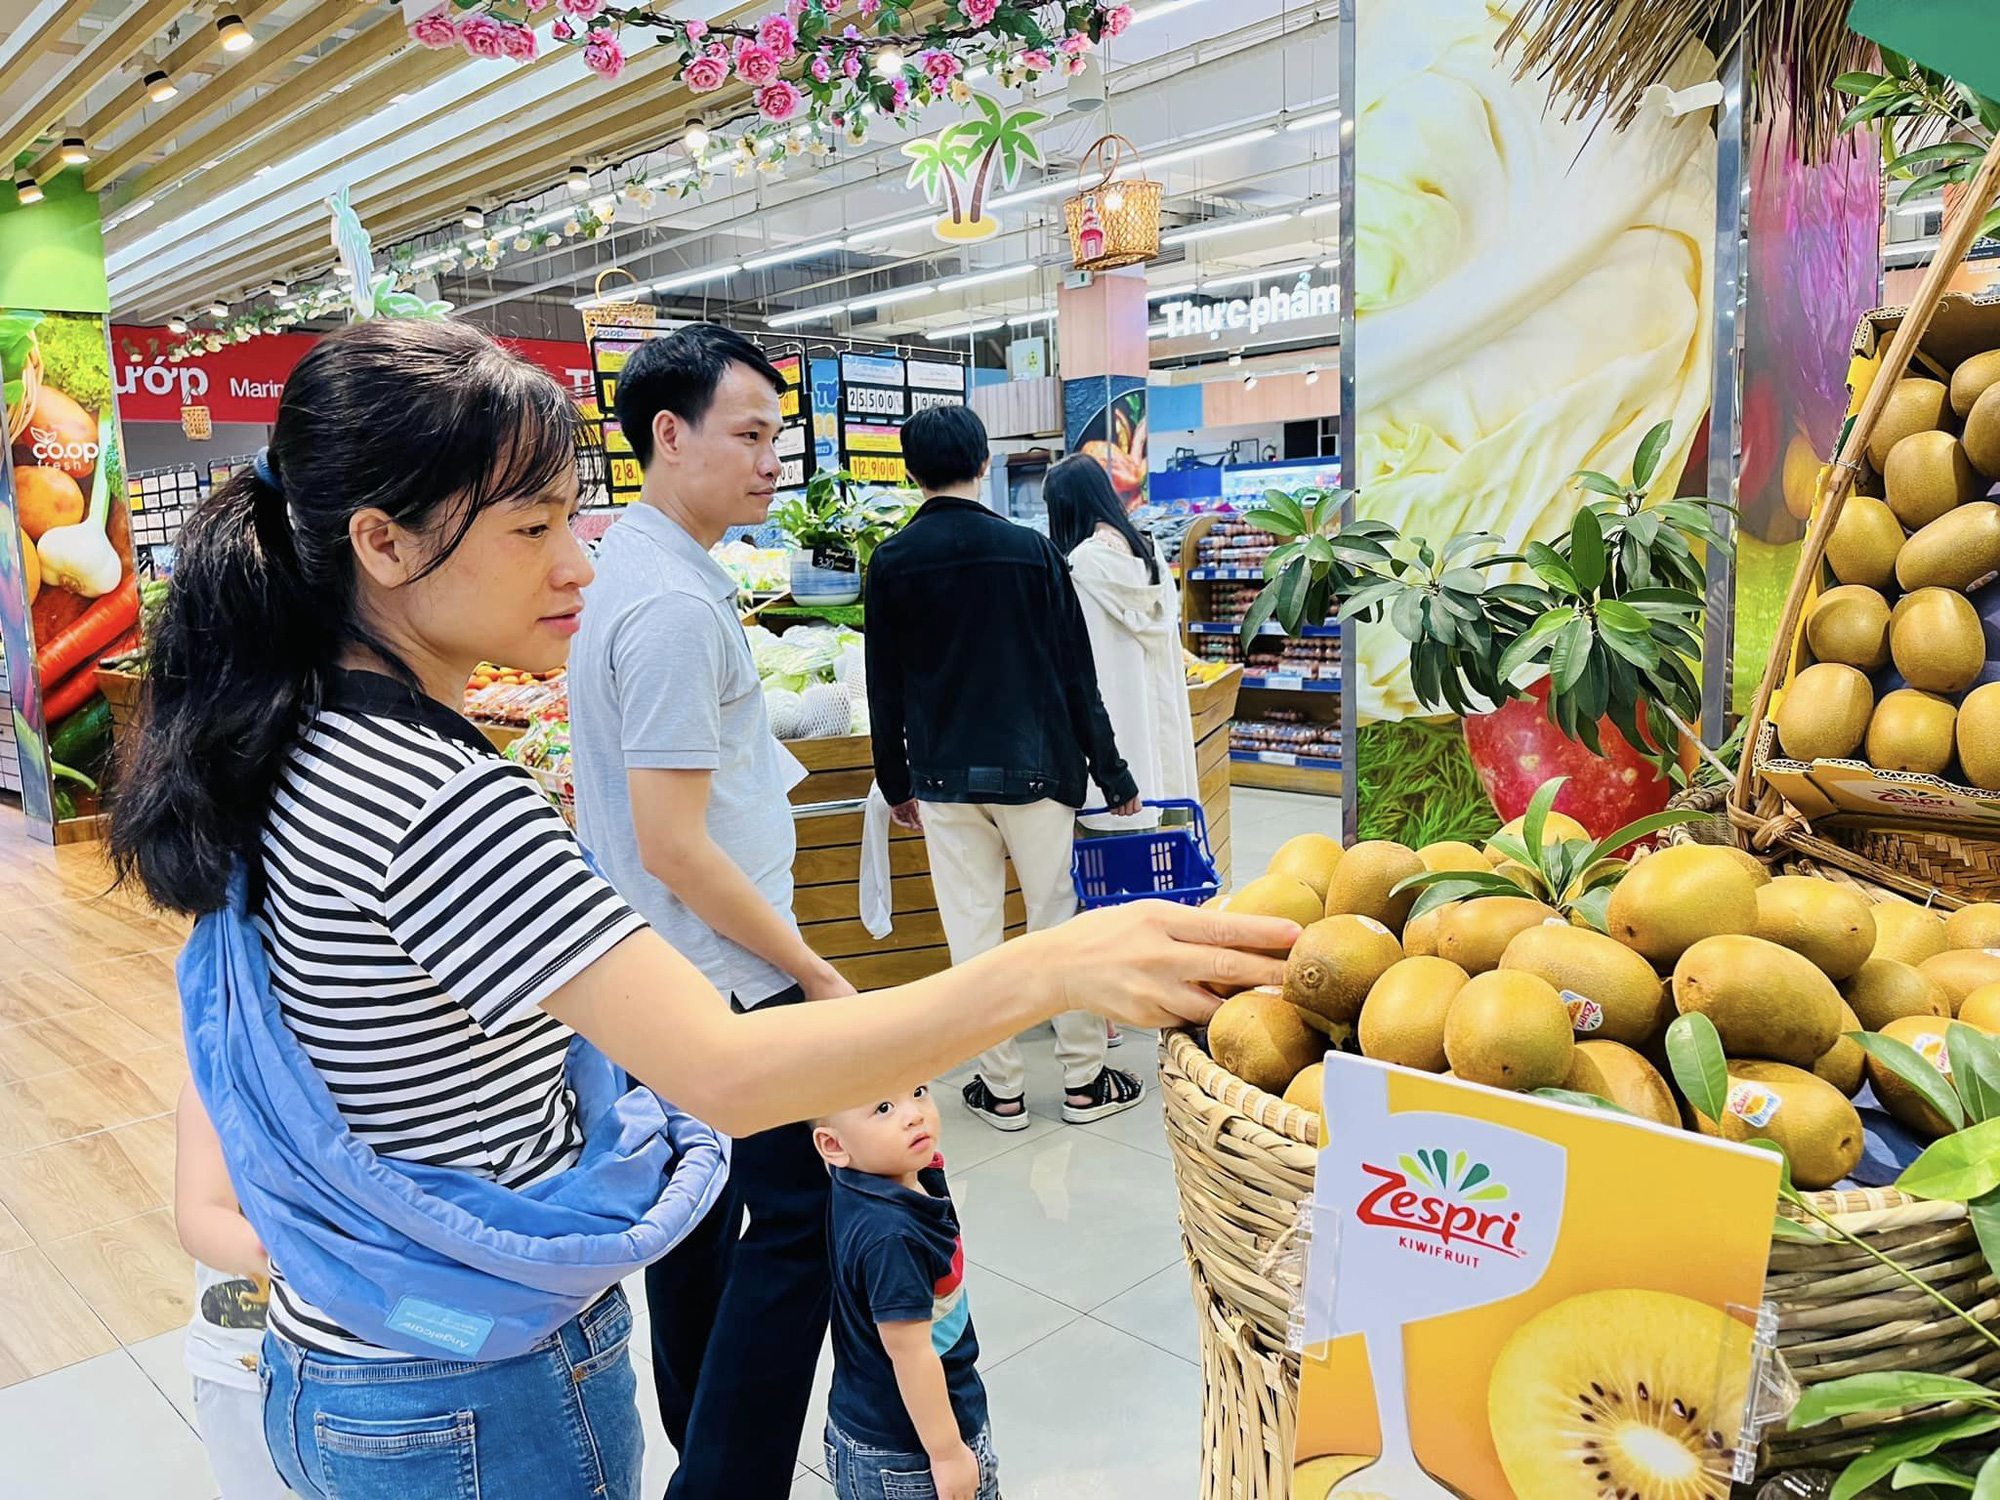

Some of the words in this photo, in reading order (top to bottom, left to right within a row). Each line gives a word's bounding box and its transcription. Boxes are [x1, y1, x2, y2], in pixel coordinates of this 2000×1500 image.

[33, 442, 98, 463] co.op
[1356, 1163, 1520, 1258] Zespri
[1398, 1235, 1480, 1269] KIWIFRUIT
